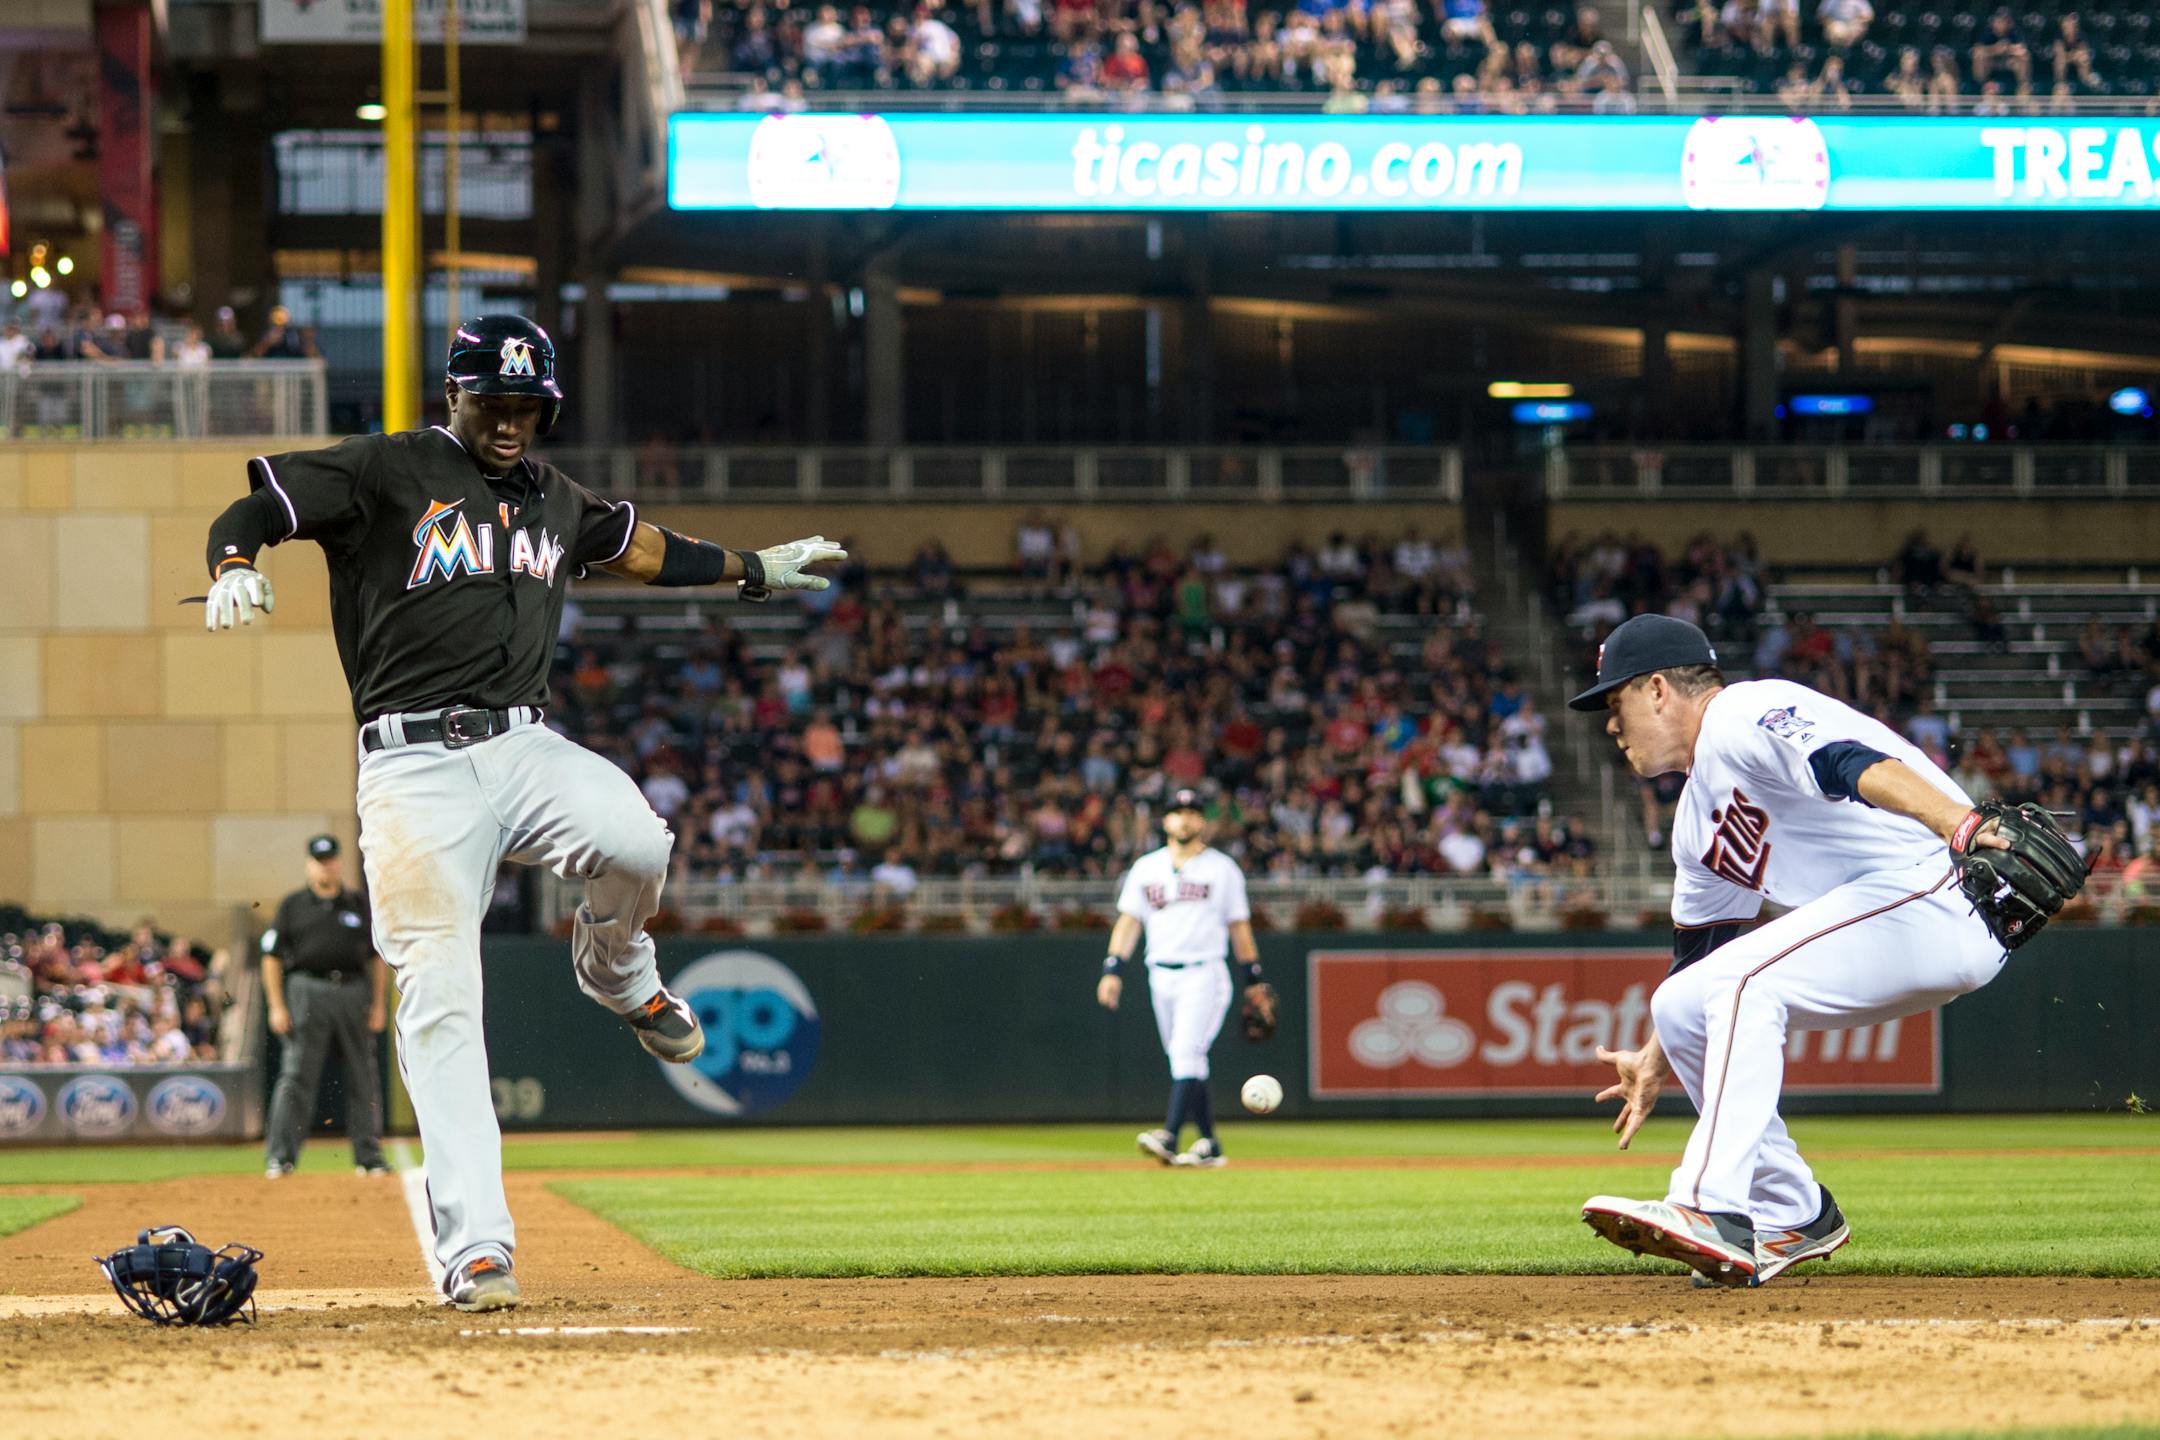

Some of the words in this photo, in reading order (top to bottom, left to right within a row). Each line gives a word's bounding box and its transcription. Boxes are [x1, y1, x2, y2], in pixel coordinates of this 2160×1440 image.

[1072, 124, 1523, 196] ticasino.com
[688, 987, 799, 1077] go
[1480, 981, 1655, 1066] Stat
